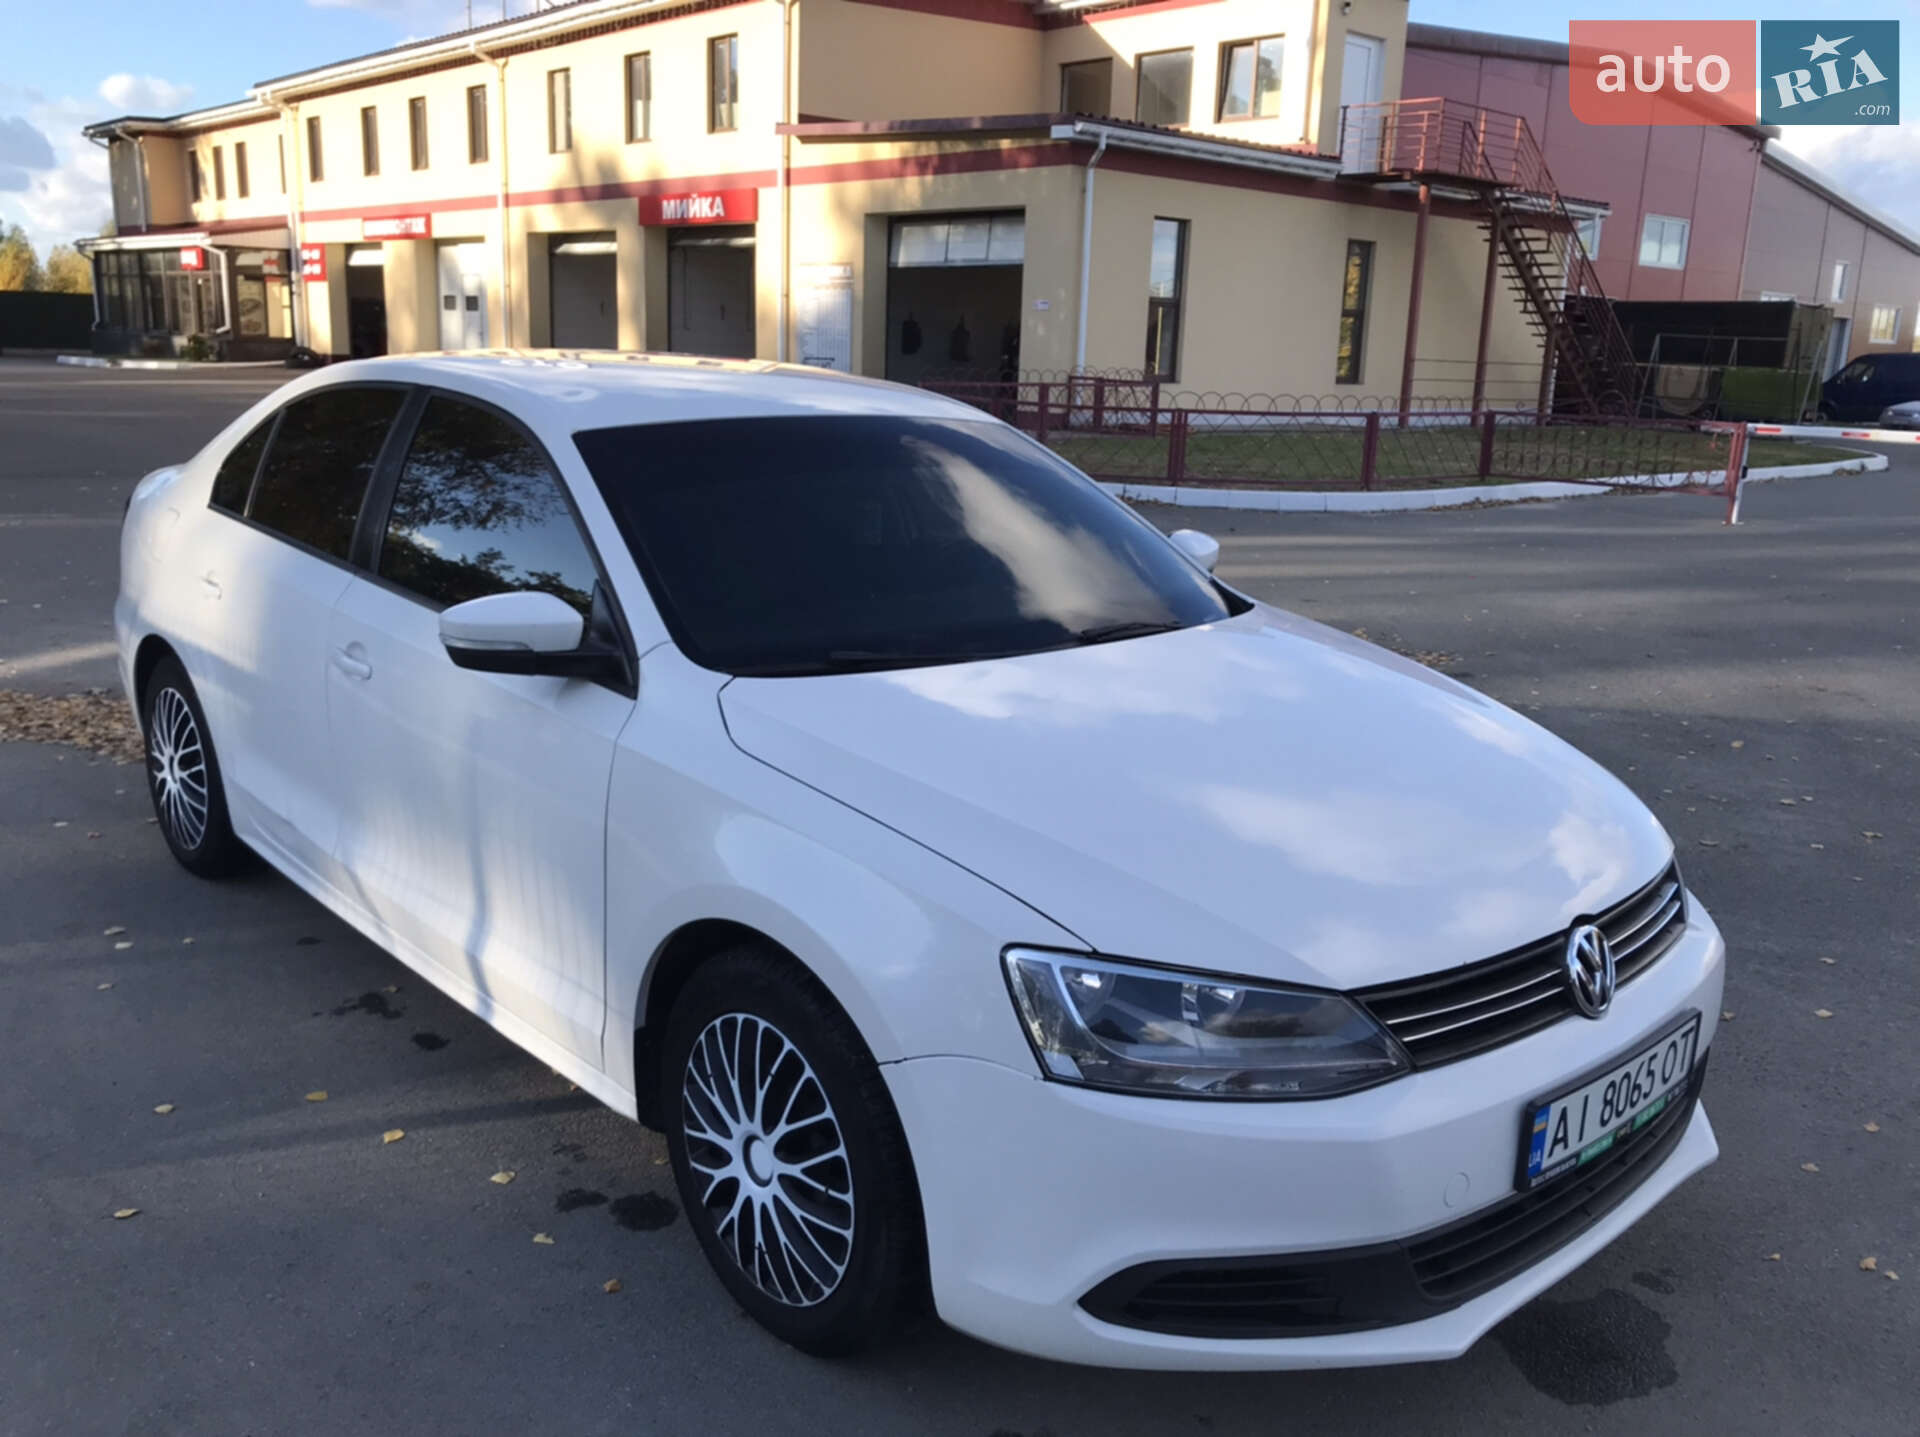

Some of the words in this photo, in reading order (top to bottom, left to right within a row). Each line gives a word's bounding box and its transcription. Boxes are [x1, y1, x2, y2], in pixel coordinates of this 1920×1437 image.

[662, 193, 725, 220] МИЙКА
[1548, 1094, 1589, 1158] AI
[1599, 1053, 1658, 1127] 8065
[1661, 1026, 1695, 1085] OT
